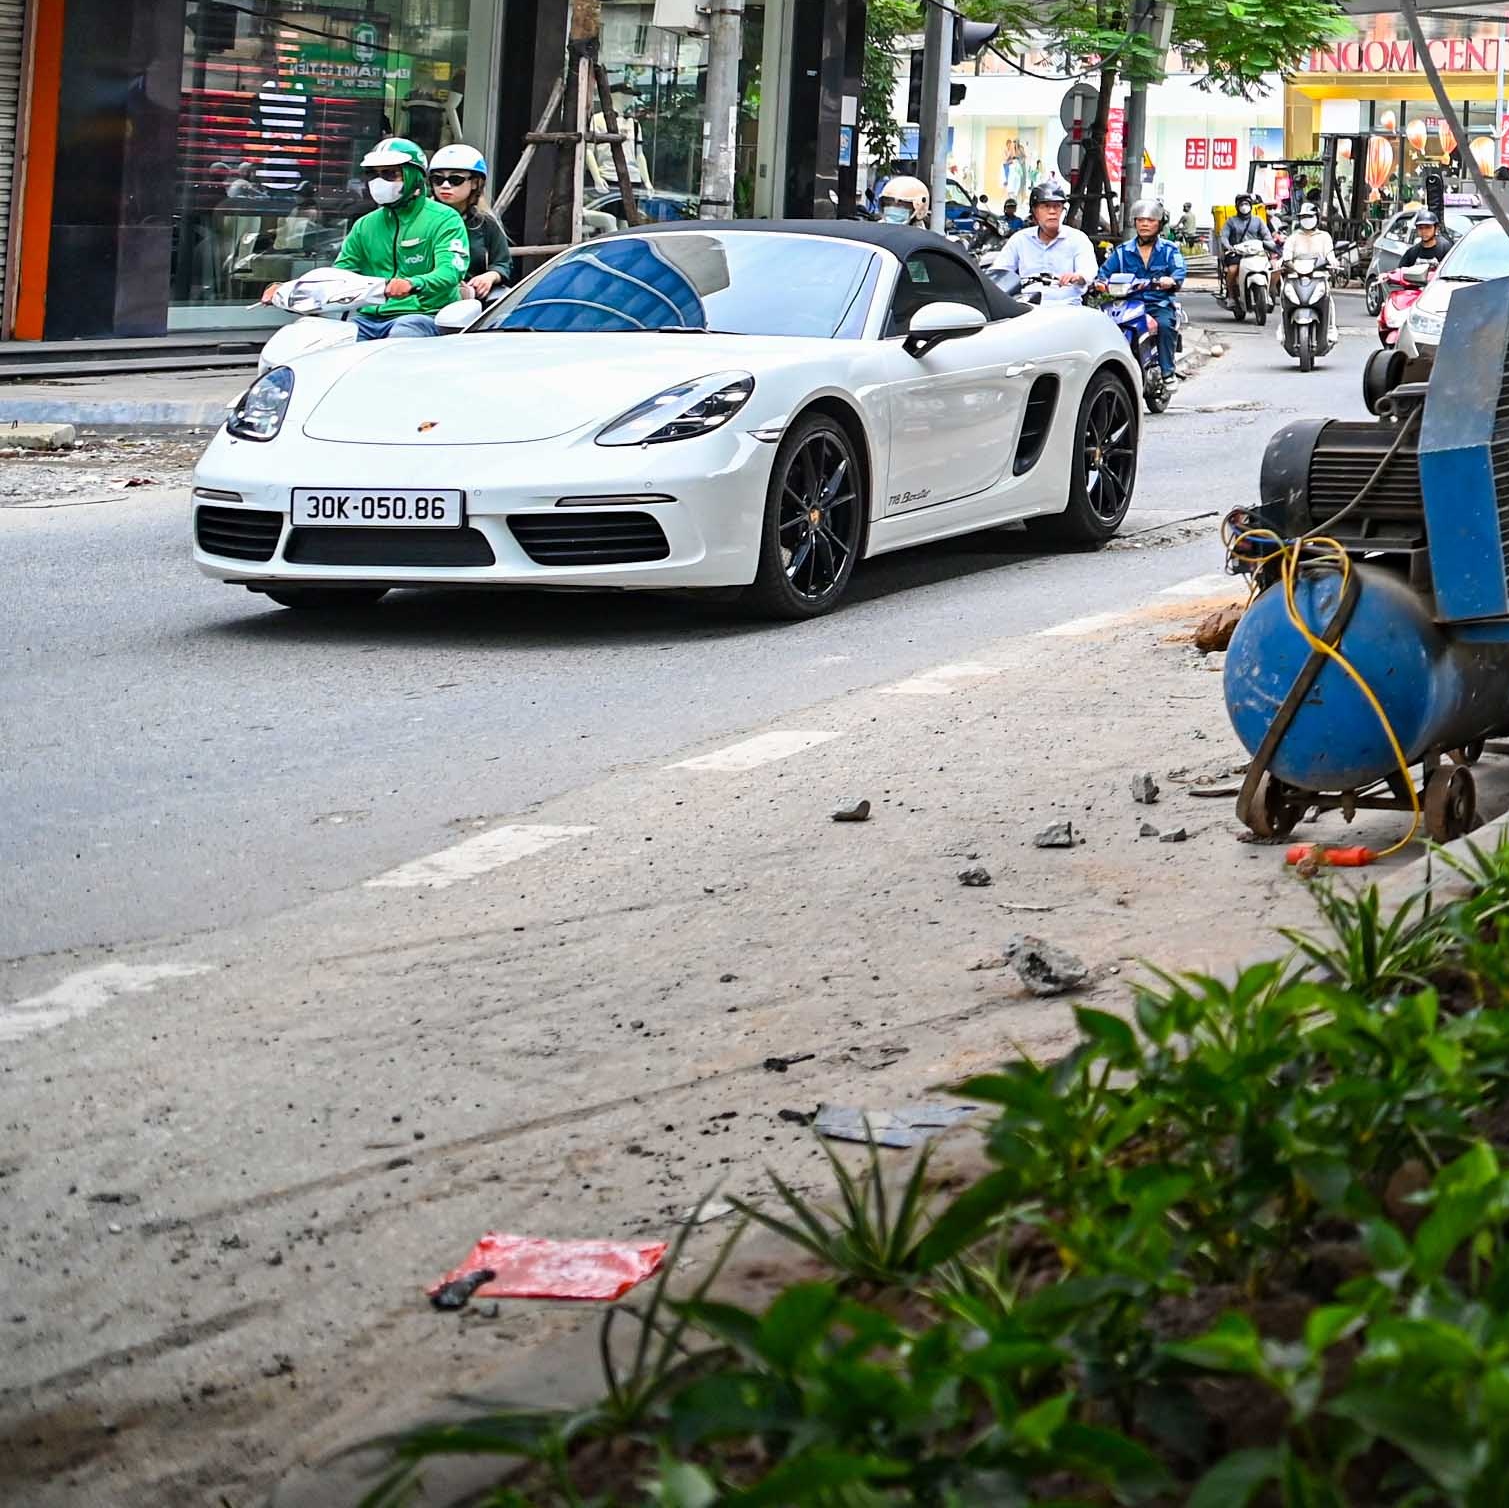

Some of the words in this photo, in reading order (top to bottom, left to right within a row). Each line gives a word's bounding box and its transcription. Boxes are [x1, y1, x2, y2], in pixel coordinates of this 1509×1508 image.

[1310, 40, 1417, 73] INCOM
[1213, 141, 1232, 153] UNI
[1213, 154, 1233, 167] QLO
[306, 495, 446, 520] 30K-050.86
